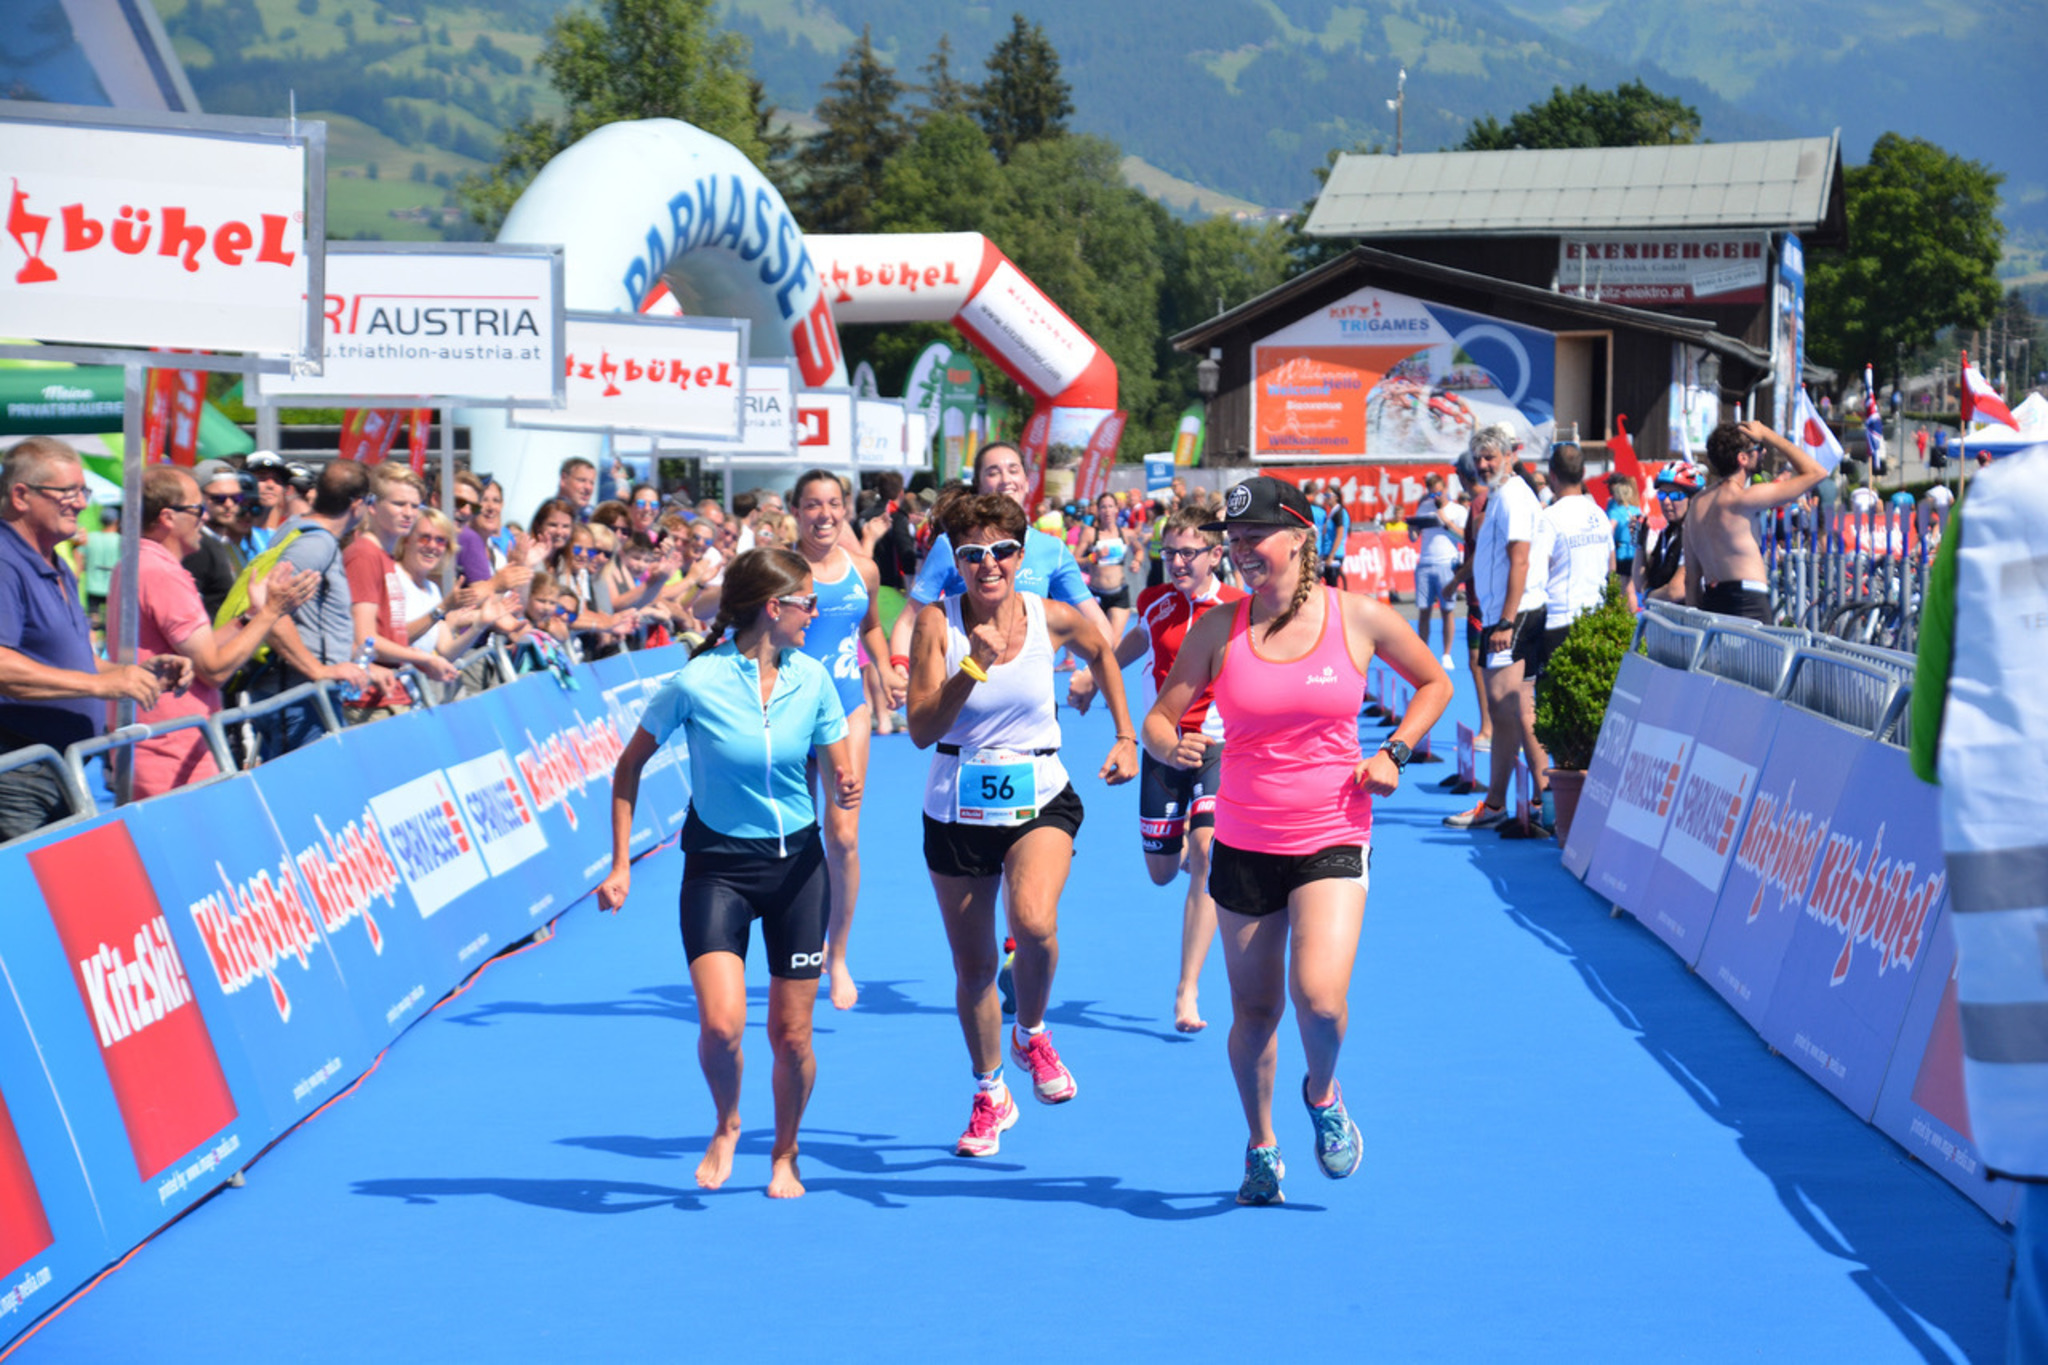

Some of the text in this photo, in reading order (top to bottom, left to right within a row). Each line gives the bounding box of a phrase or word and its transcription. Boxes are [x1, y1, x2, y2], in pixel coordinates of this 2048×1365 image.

[617, 173, 815, 321] PARKASSE
[1565, 243, 1761, 259] EXENBERGER
[366, 307, 540, 337] AUSTRIA
[1340, 318, 1430, 332] TRIGAMES
[282, 342, 541, 361] .triathlon-austria.at
[7, 401, 124, 418] PRIVATBRAUERE
[981, 775, 1015, 800] 56
[1674, 773, 1734, 853] SPARKASSE
[1806, 821, 1940, 986] Kitzbühel
[190, 859, 322, 1023] Kitzbühel
[80, 914, 193, 1049] KitzSki!
